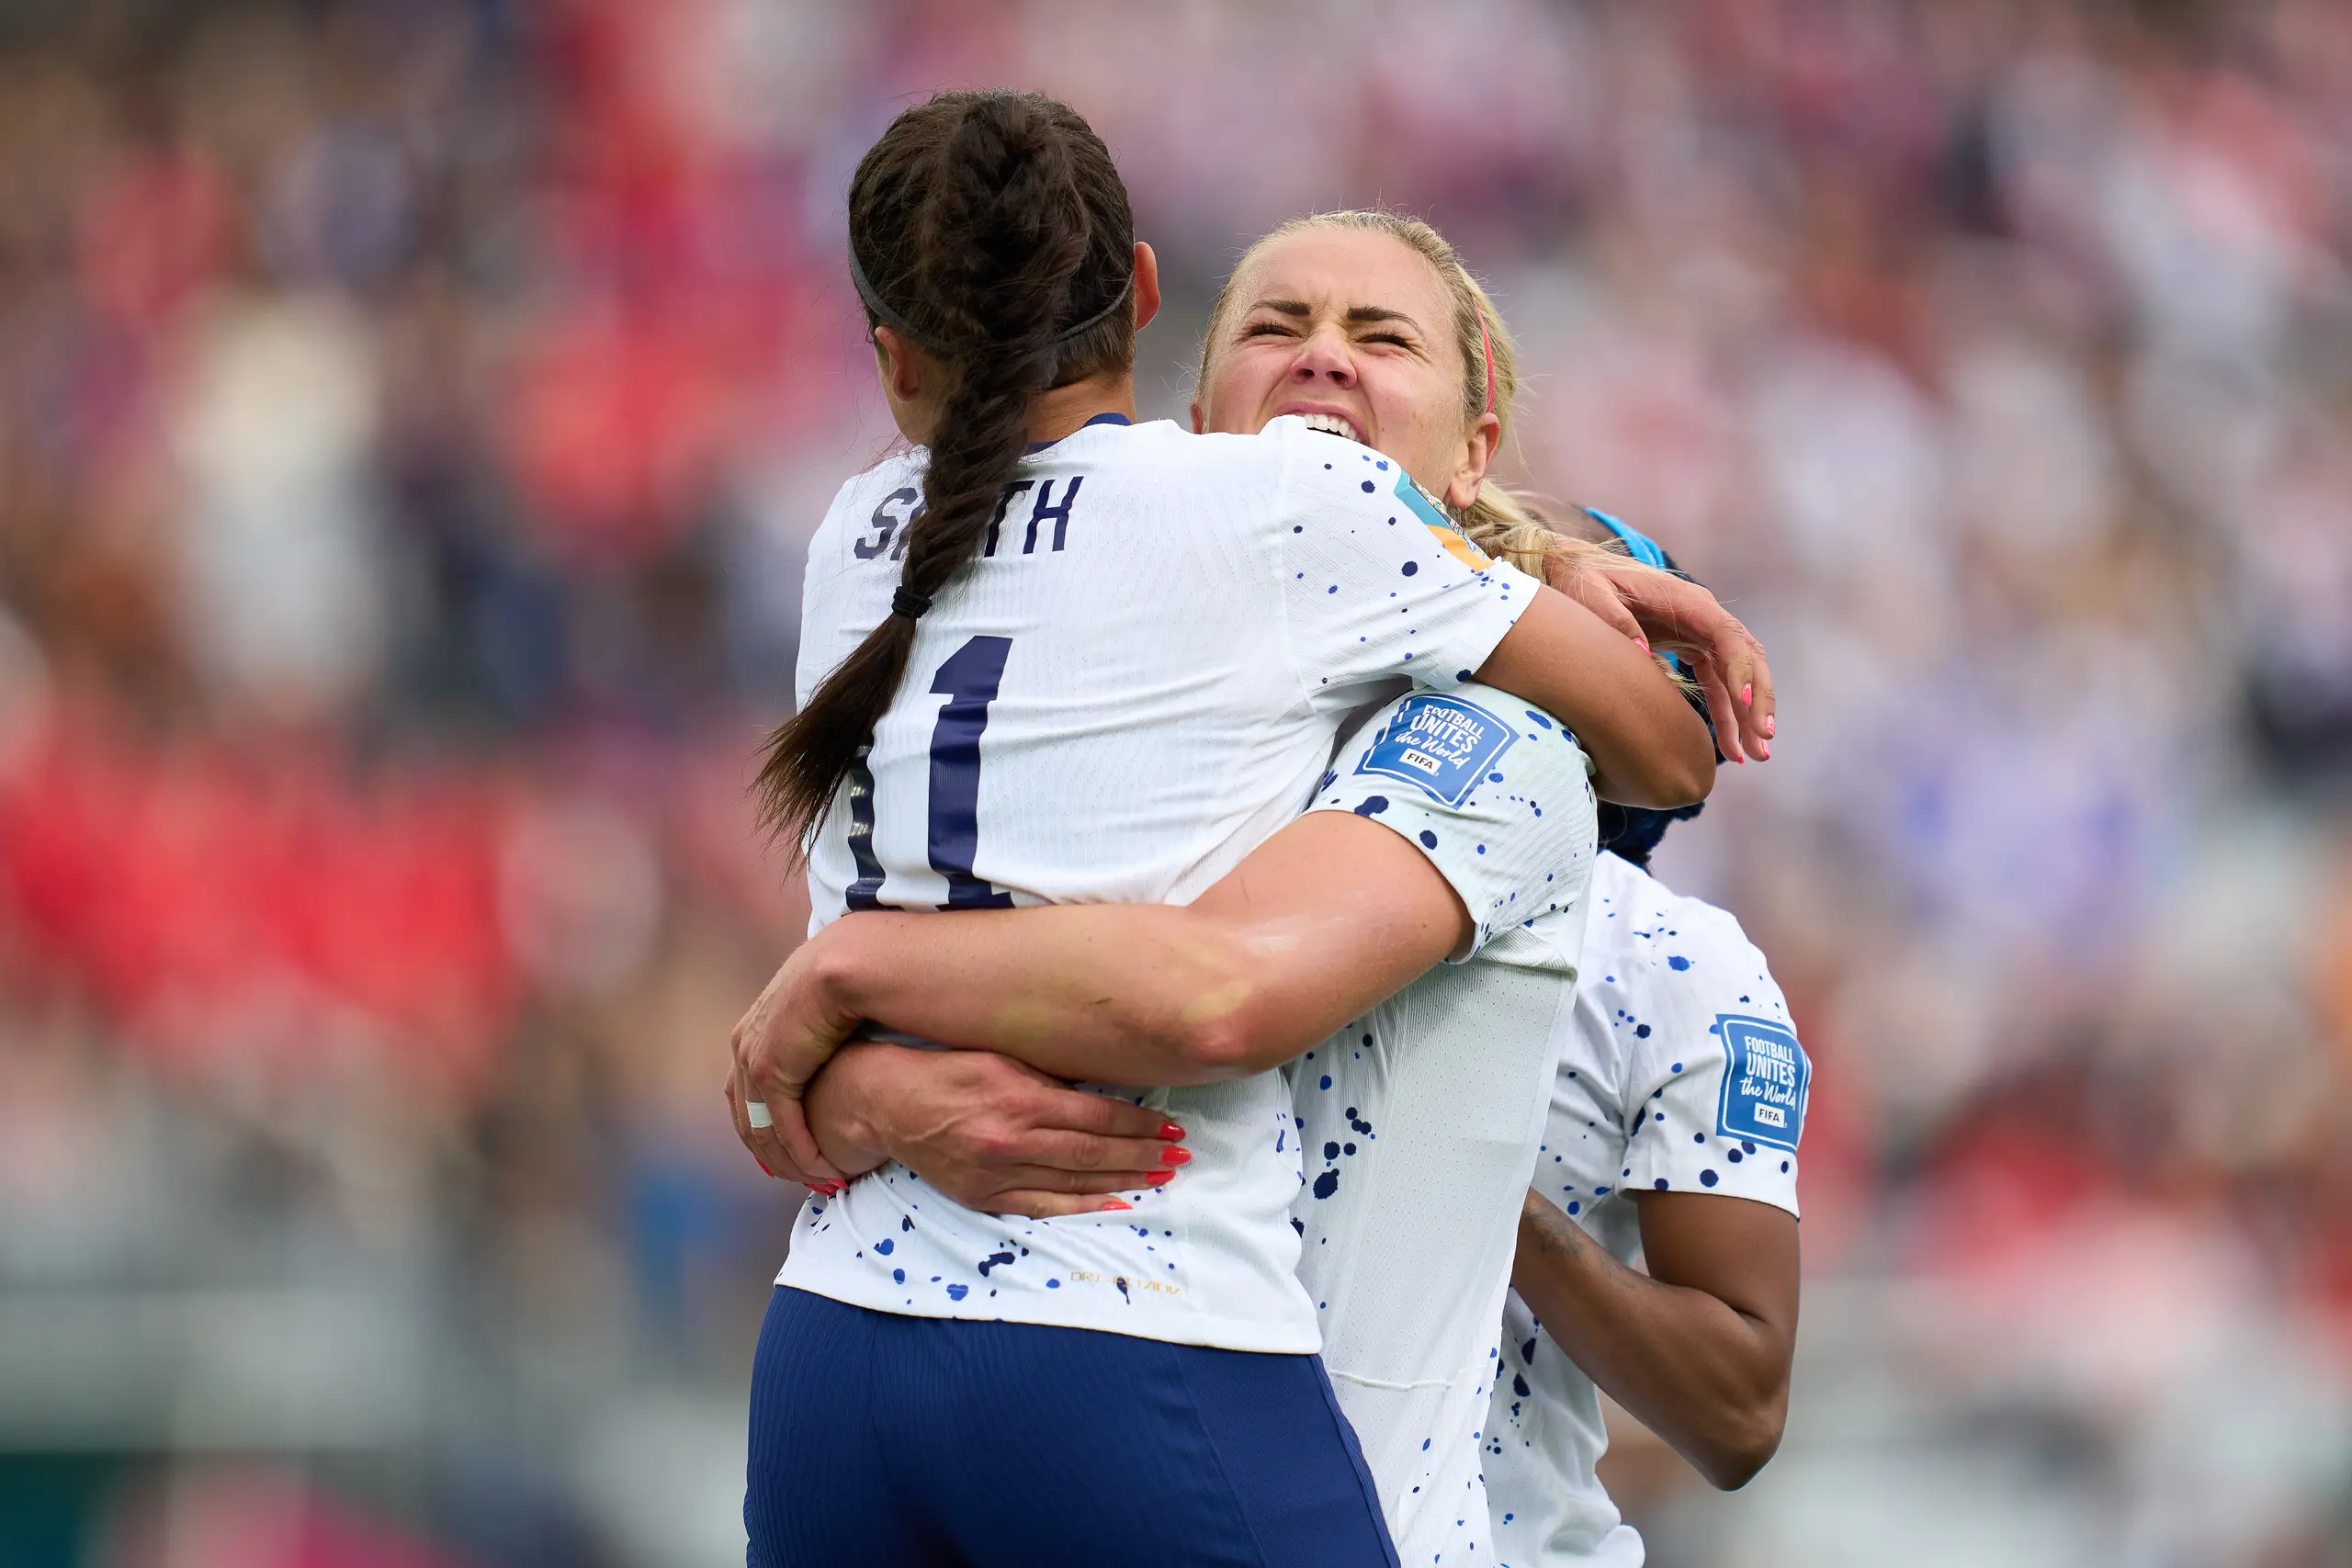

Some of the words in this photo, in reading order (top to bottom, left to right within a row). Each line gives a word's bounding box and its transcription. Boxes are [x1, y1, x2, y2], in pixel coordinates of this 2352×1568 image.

[854, 476, 1084, 561] STH
[1409, 713, 1478, 754] UNITES
[1421, 704, 1486, 740] FOOTBALL
[1394, 729, 1422, 746] the
[1420, 736, 1471, 770] World
[1406, 751, 1434, 770] FIFA
[1744, 1035, 1795, 1065] FOOTBALL
[1746, 1052, 1796, 1088] UNITES
[1739, 1076, 1763, 1097] the
[1763, 1080, 1797, 1111] World
[1758, 1108, 1781, 1122] FIFA
